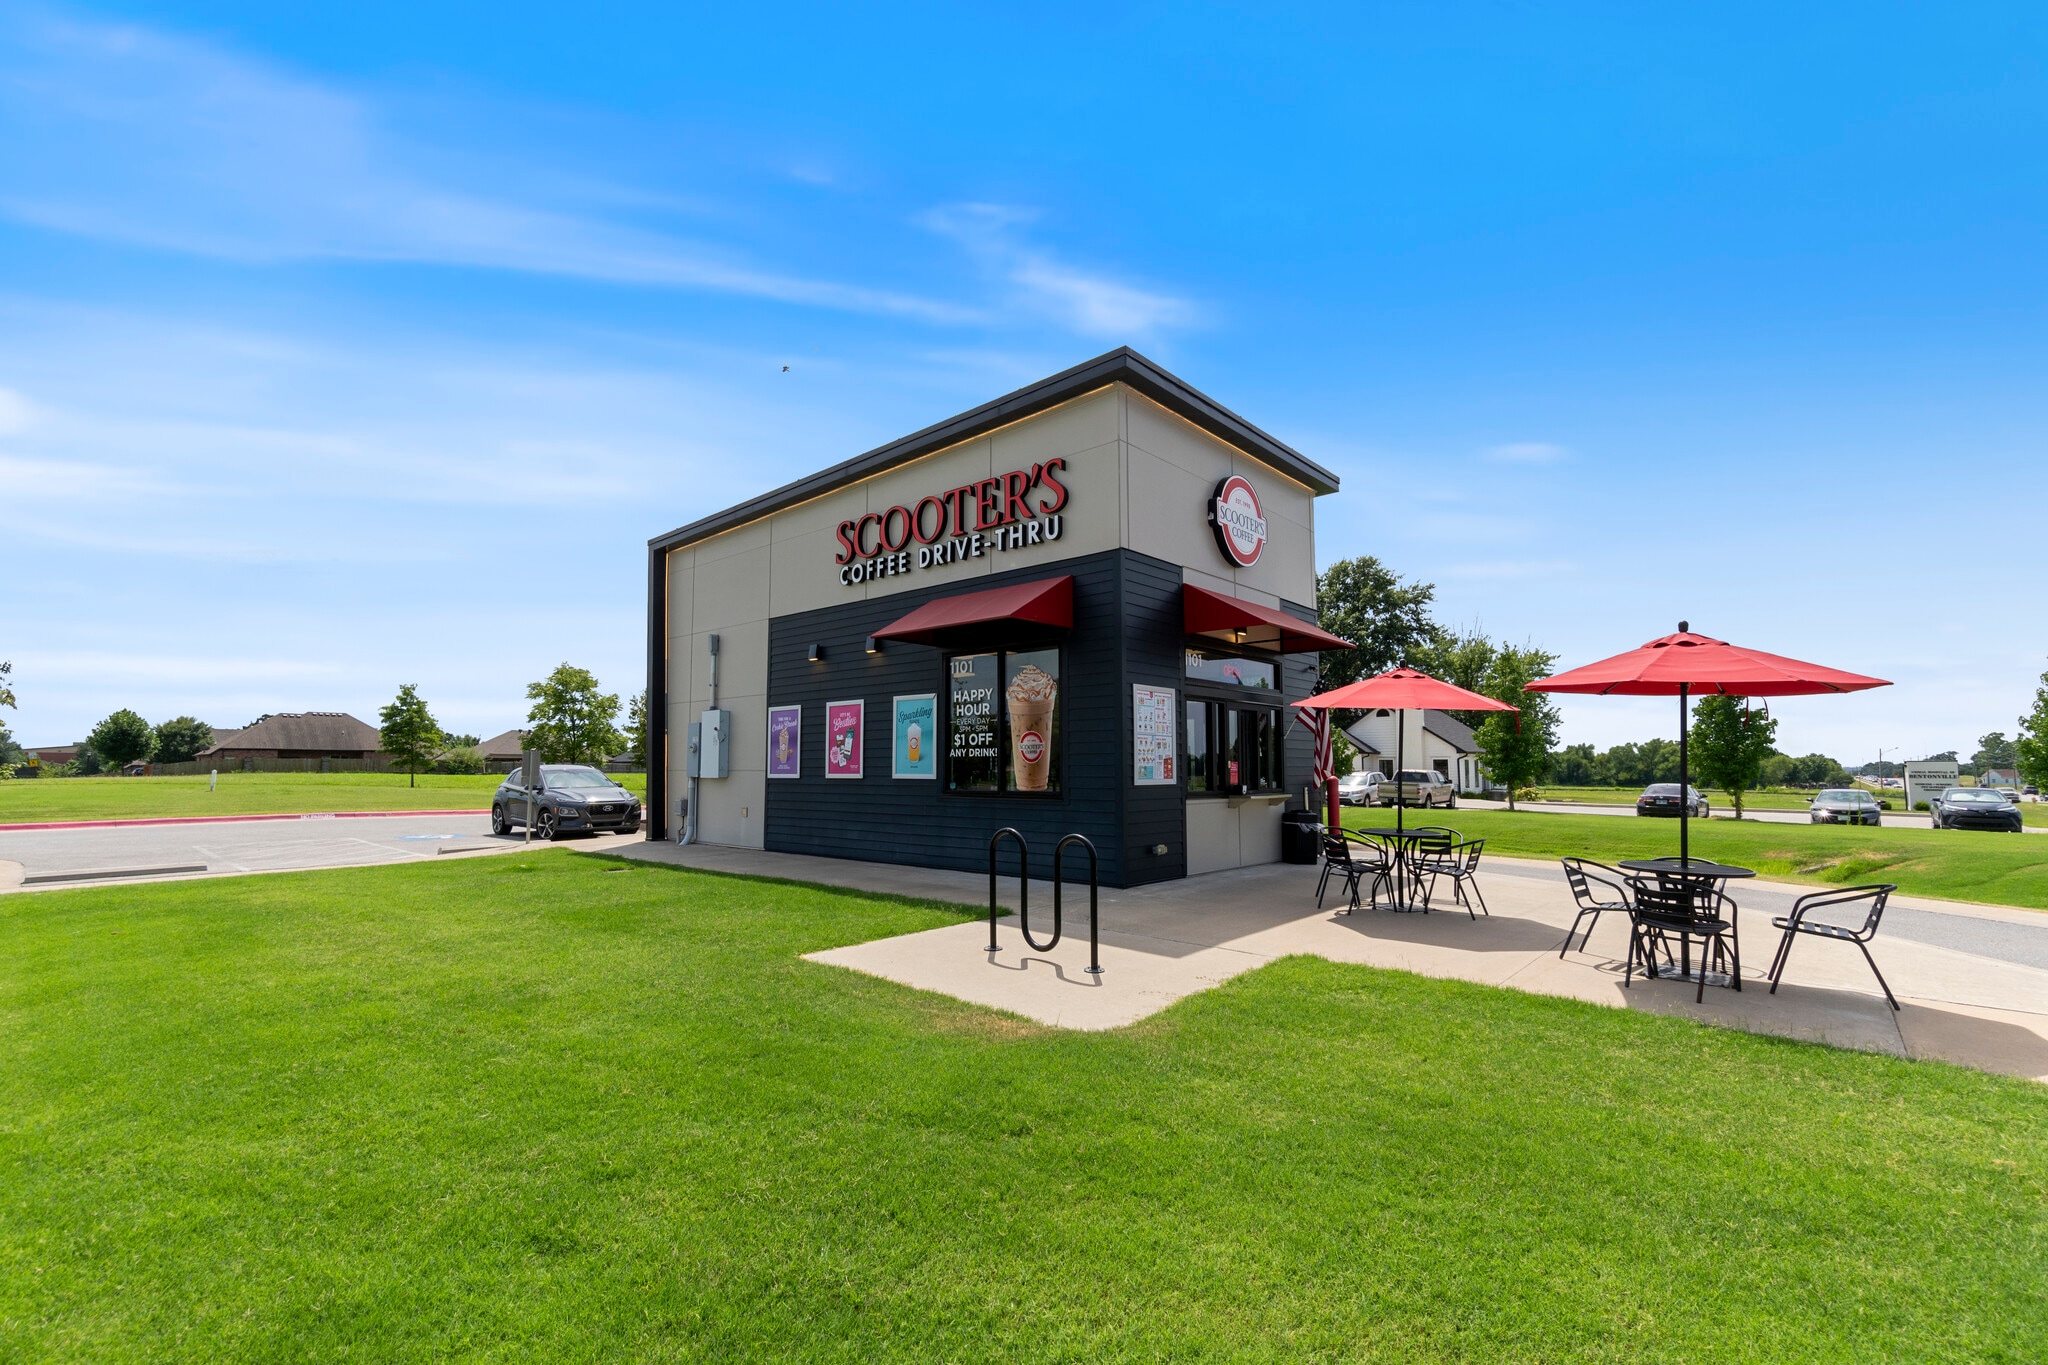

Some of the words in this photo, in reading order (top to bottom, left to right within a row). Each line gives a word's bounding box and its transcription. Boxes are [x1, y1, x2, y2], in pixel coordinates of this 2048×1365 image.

[836, 458, 1068, 565] SCOOTER'S
[1220, 505, 1265, 536] SCOOTER'S
[1231, 526, 1254, 544] COFFEE
[839, 552, 910, 586] COFFEE
[919, 514, 1062, 569] DRIVE-THRU
[950, 660, 973, 674] 1101
[954, 688, 993, 702] HAPPY
[898, 707, 933, 724] Sparkling
[956, 703, 990, 716] HOUR
[956, 717, 975, 725] EVERY
[976, 717, 990, 725] DAY
[954, 733, 965, 747] $1
[969, 733, 993, 745] OFF
[950, 749, 966, 757] ANY
[969, 748, 998, 757] DRINK!
